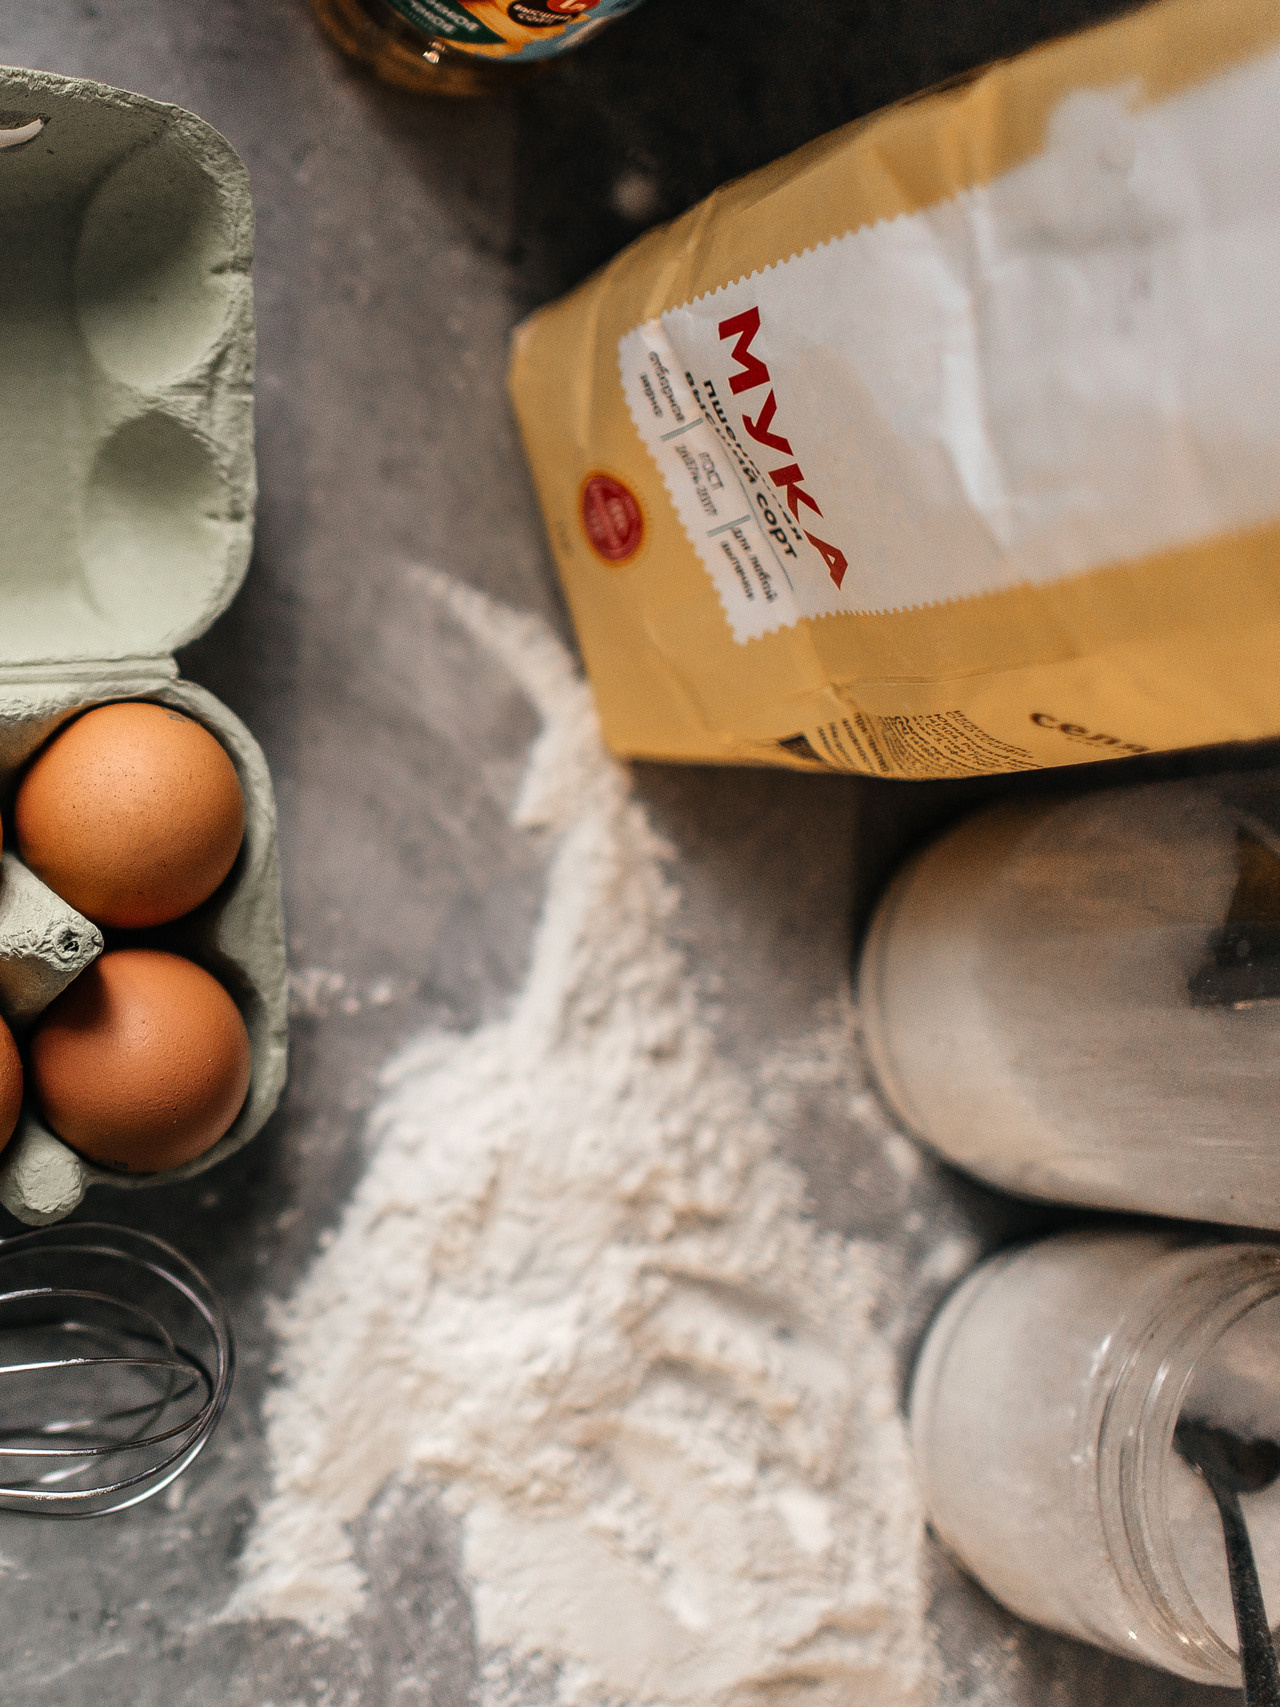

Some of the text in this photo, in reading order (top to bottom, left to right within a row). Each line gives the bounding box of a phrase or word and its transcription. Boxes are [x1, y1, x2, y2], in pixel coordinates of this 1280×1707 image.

[698, 451, 725, 490] ГОСТ
[718, 305, 849, 591] МУКА
[756, 491, 799, 559] сорт
